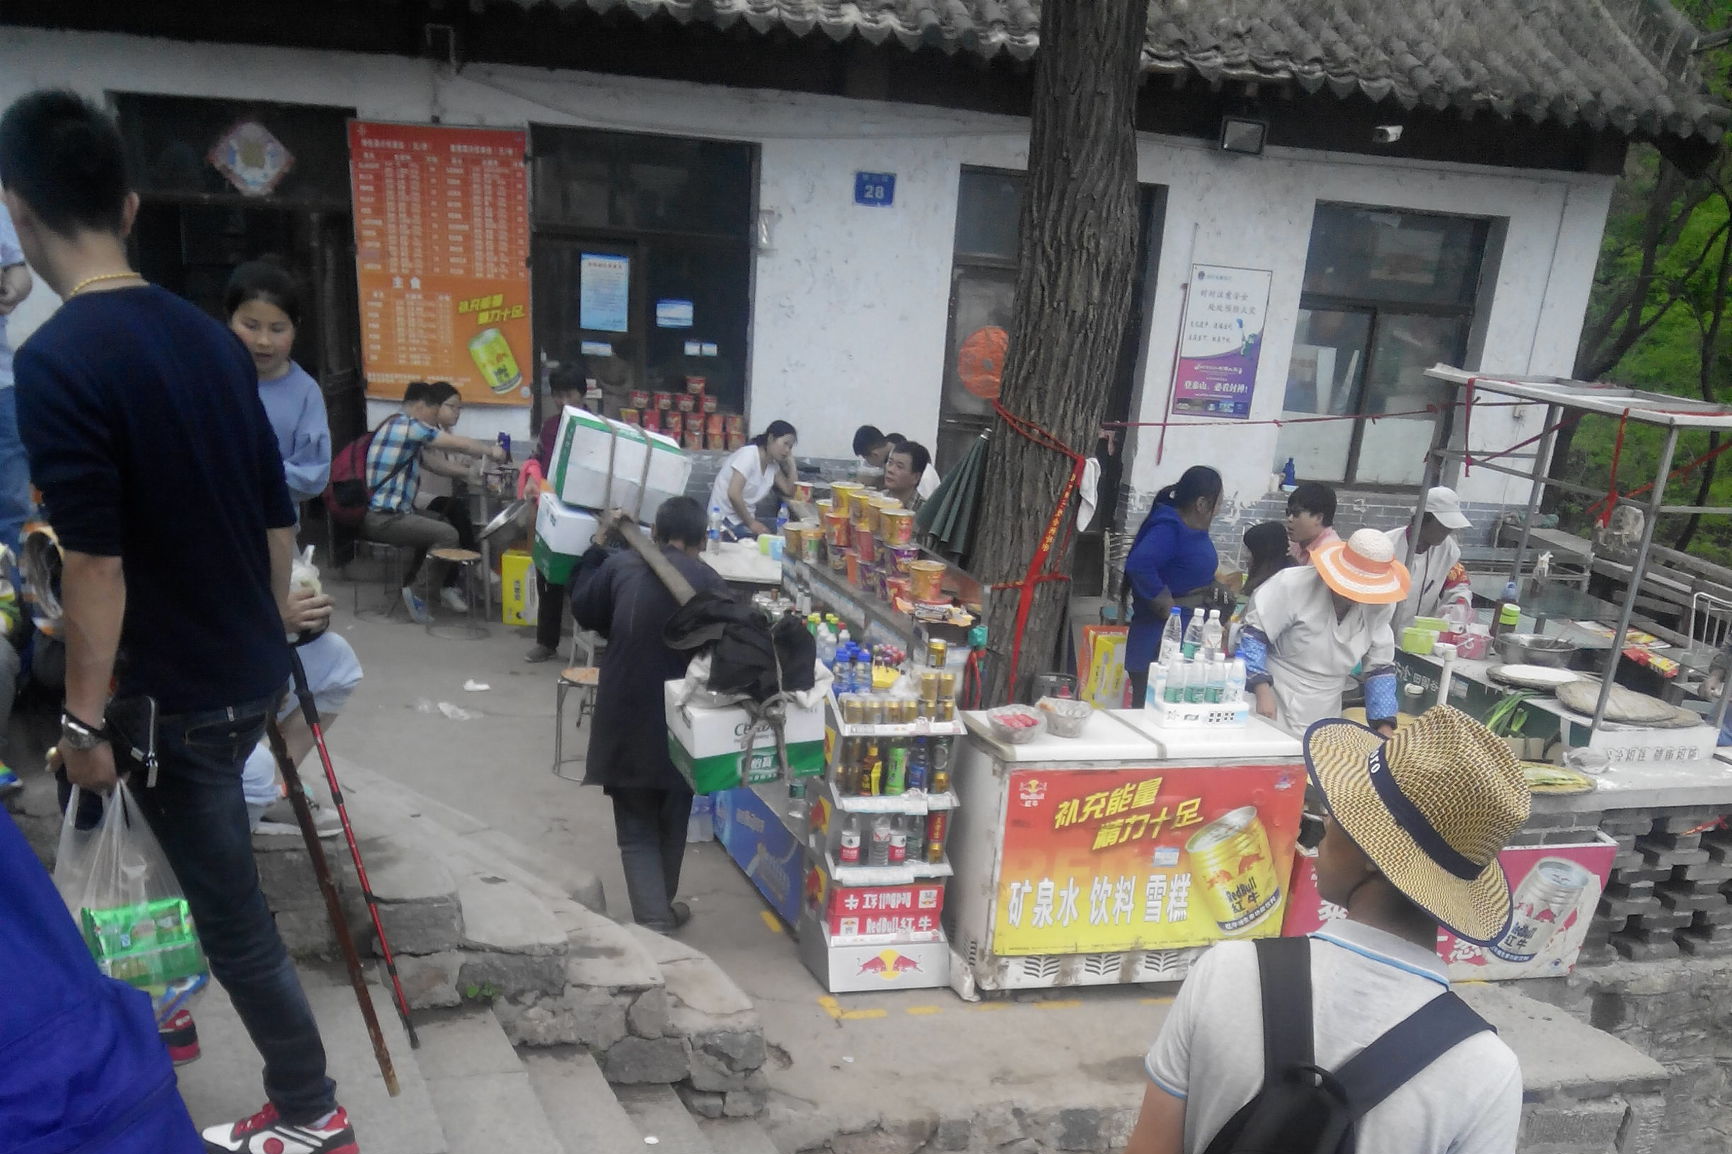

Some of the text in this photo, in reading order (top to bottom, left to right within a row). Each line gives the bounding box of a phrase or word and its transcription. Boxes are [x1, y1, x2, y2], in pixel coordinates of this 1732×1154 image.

[1055, 776, 1163, 830] 补充能量
[1092, 797, 1204, 851] 精力十足
[878, 891, 912, 910] RedBull
[1008, 872, 1192, 929] 矿泉水 饮料 雪糕
[1226, 875, 1258, 903] RedBull
[1231, 891, 1261, 914] 红牛
[866, 917, 899, 935] RedBull
[1503, 934, 1529, 950] 红牛
